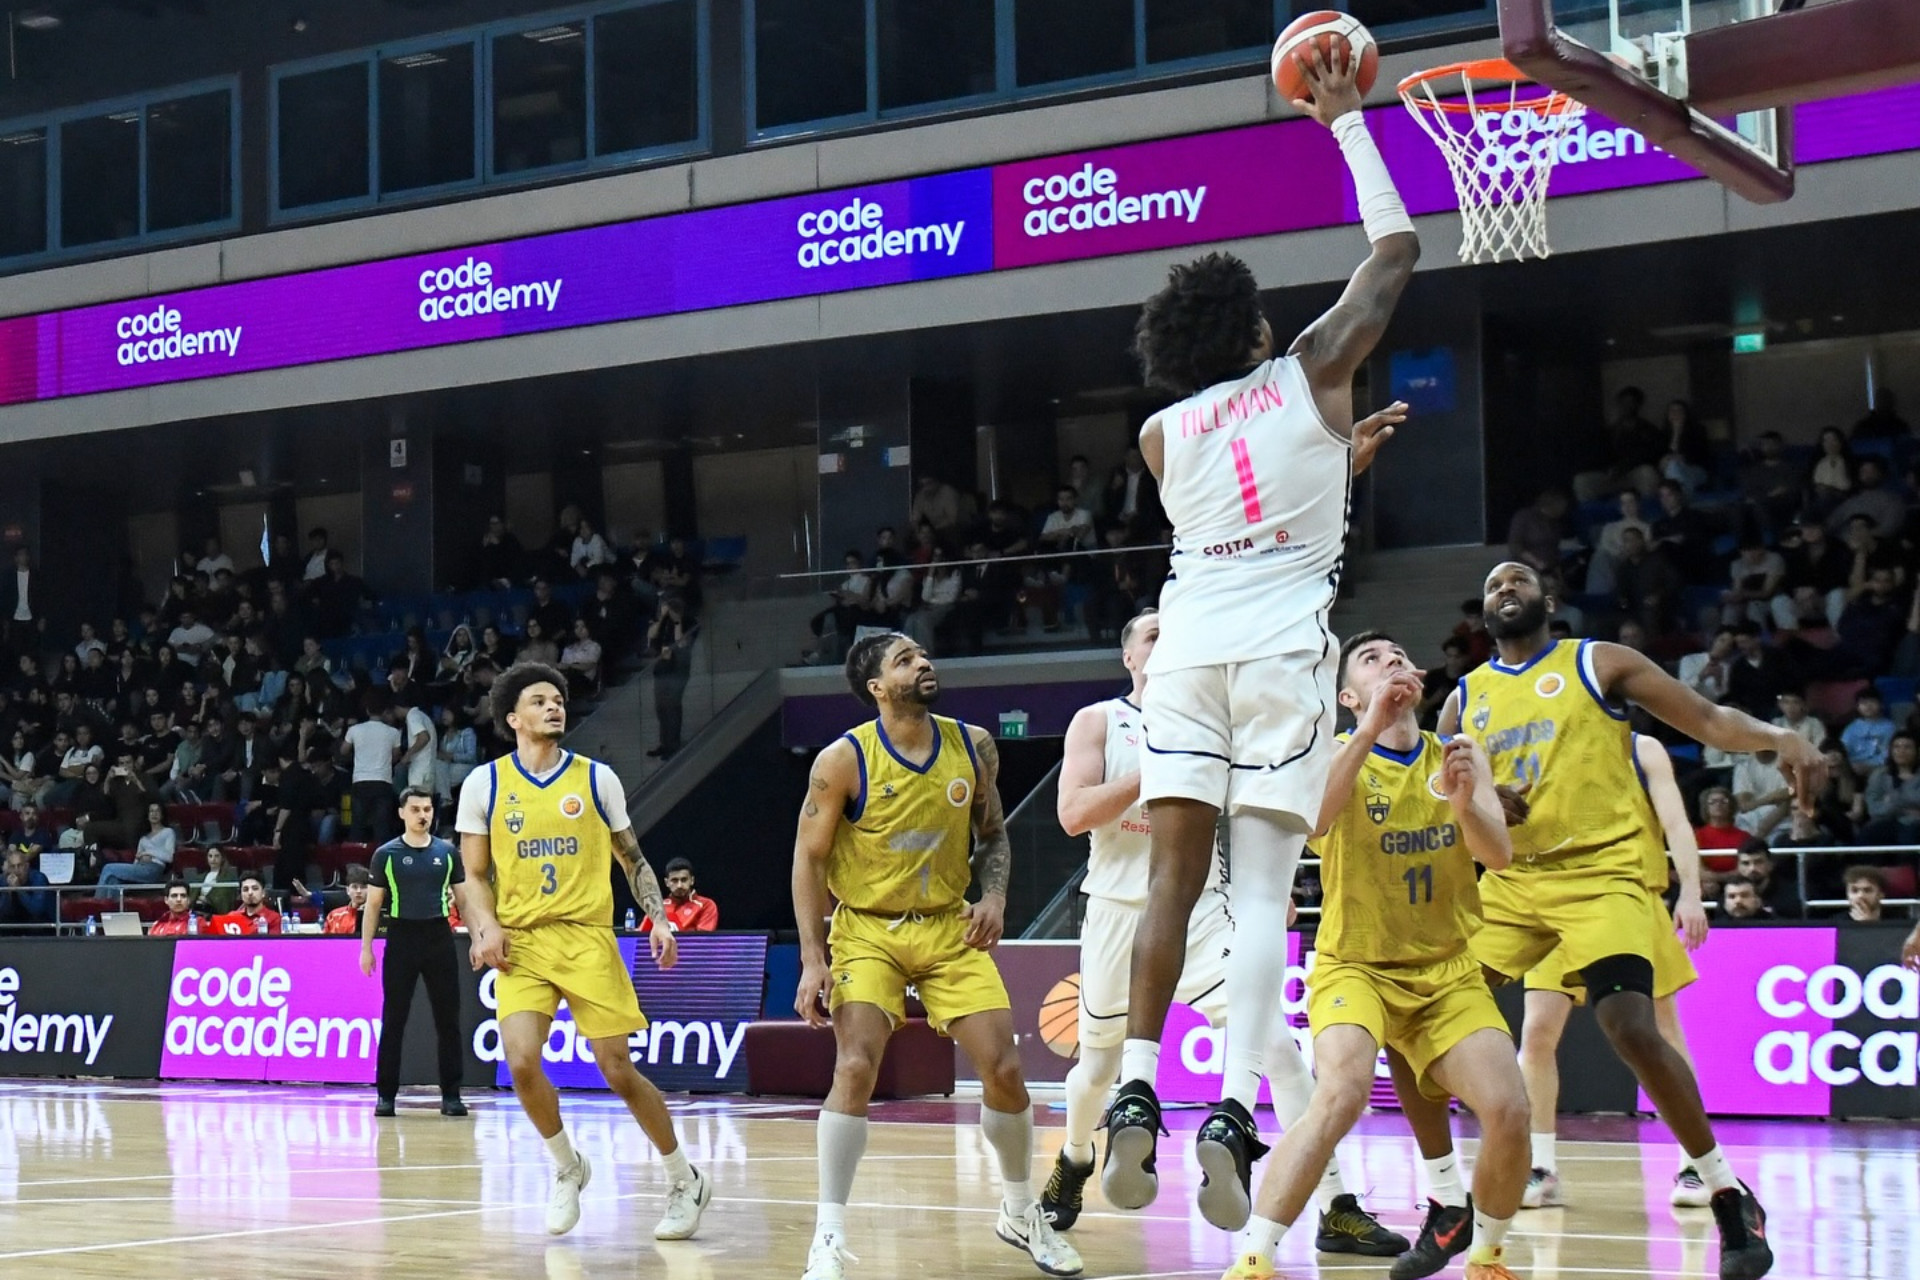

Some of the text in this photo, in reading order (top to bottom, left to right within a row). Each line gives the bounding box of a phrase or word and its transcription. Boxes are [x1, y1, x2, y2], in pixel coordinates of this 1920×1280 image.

[1478, 123, 1664, 175] academ
[1023, 162, 1117, 205] code
[797, 197, 883, 238] code
[1023, 187, 1206, 237] academy
[797, 221, 965, 269] academy
[419, 256, 493, 294] code
[116, 304, 182, 339] code
[419, 279, 562, 322] academy
[117, 327, 242, 366] academy
[1181, 381, 1284, 438] TILLMAN
[1230, 437, 1263, 524] 1
[1203, 538, 1254, 556] COSTA
[540, 862, 557, 895] 3
[1402, 865, 1433, 905] 11
[171, 955, 292, 1008] code
